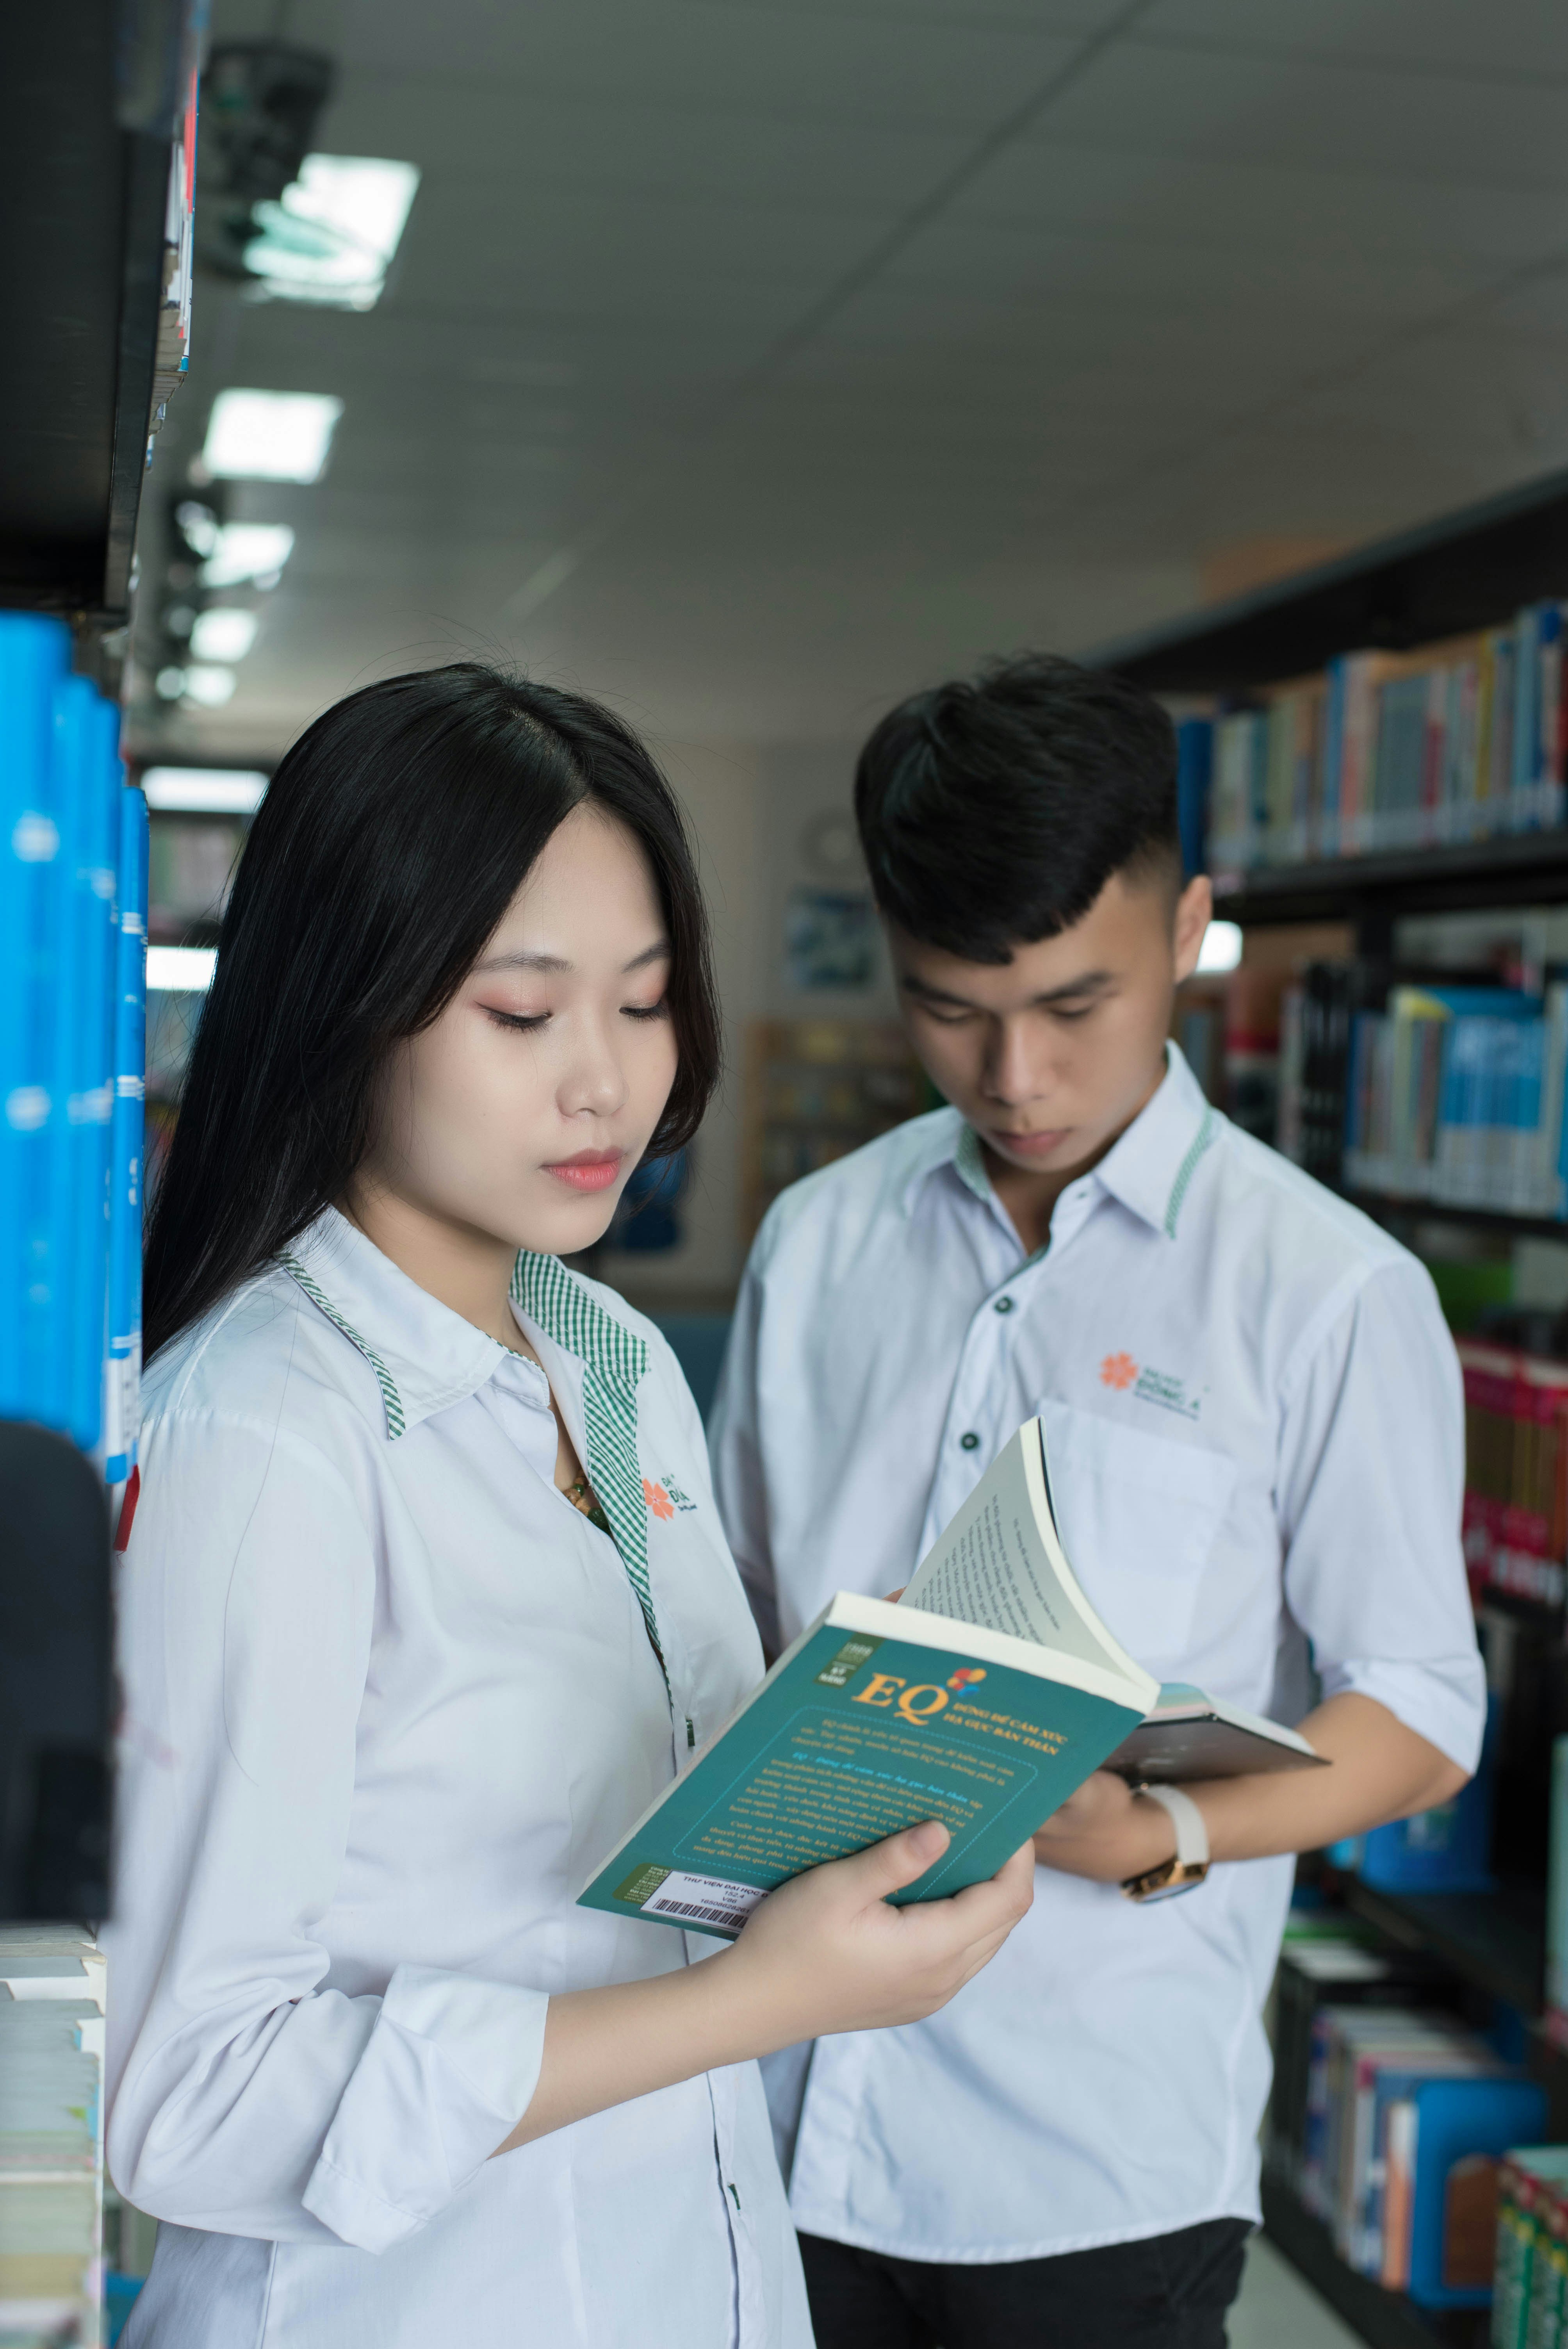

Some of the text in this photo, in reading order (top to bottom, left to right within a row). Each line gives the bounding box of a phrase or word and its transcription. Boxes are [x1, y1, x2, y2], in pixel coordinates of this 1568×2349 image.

[851, 1673, 949, 1725] EQ
[1023, 1736, 1059, 1756] THÂN
[704, 1880, 723, 1888] VIỆN
[740, 1887, 760, 1896] HỌC
